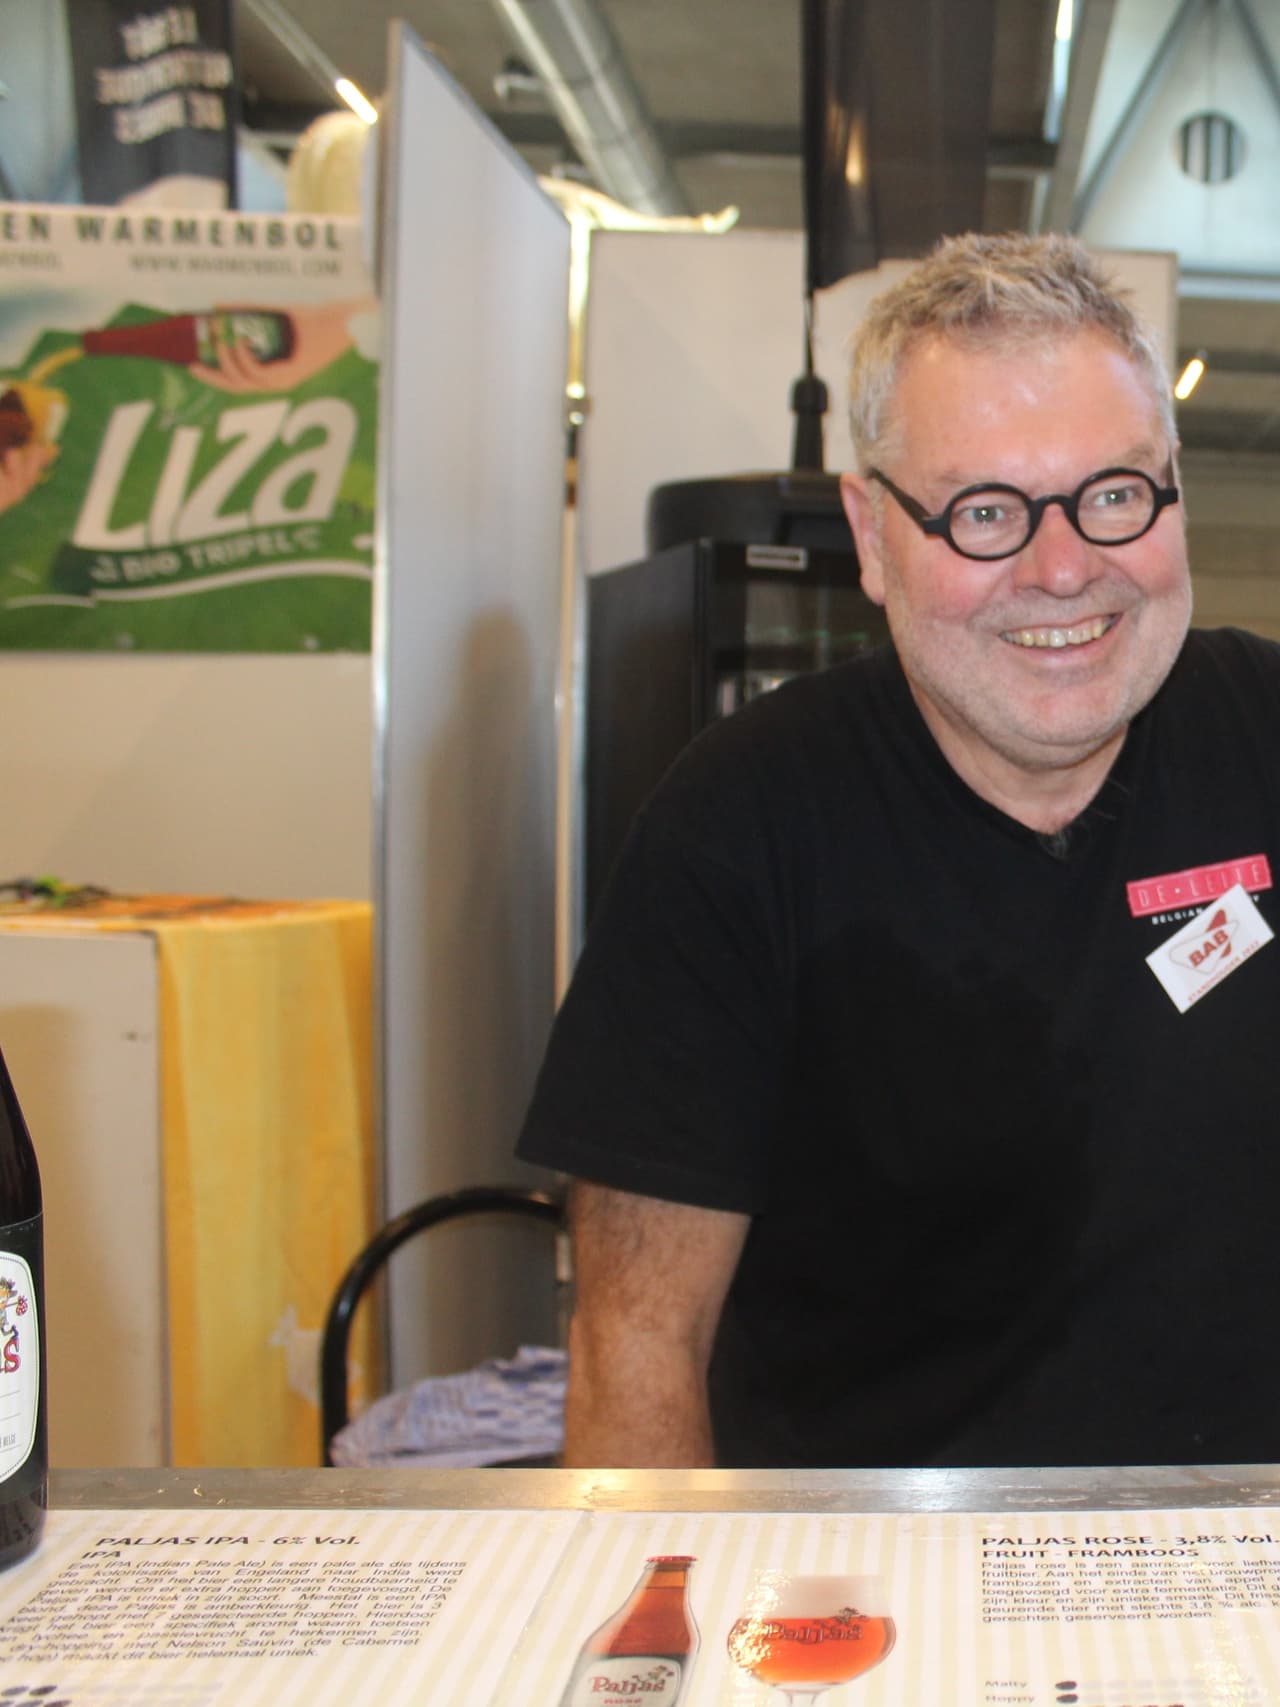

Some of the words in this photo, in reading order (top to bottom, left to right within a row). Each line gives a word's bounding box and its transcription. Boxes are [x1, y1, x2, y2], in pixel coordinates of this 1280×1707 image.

[75, 216, 342, 249] WARMENBOL
[184, 530, 292, 569] TRIPEL
[1188, 929, 1230, 968] BAB
[96, 1536, 199, 1546] PALJAS
[204, 1536, 250, 1545] IPA
[314, 1536, 361, 1545] Vol.
[981, 1537, 1077, 1546] PALJAS
[1232, 1534, 1280, 1544] Vol.
[82, 1550, 121, 1559] IPA
[983, 1550, 1049, 1558] FRUIT
[1068, 1549, 1200, 1558] FRAMBOOS
[591, 1674, 666, 1695] Paljas
